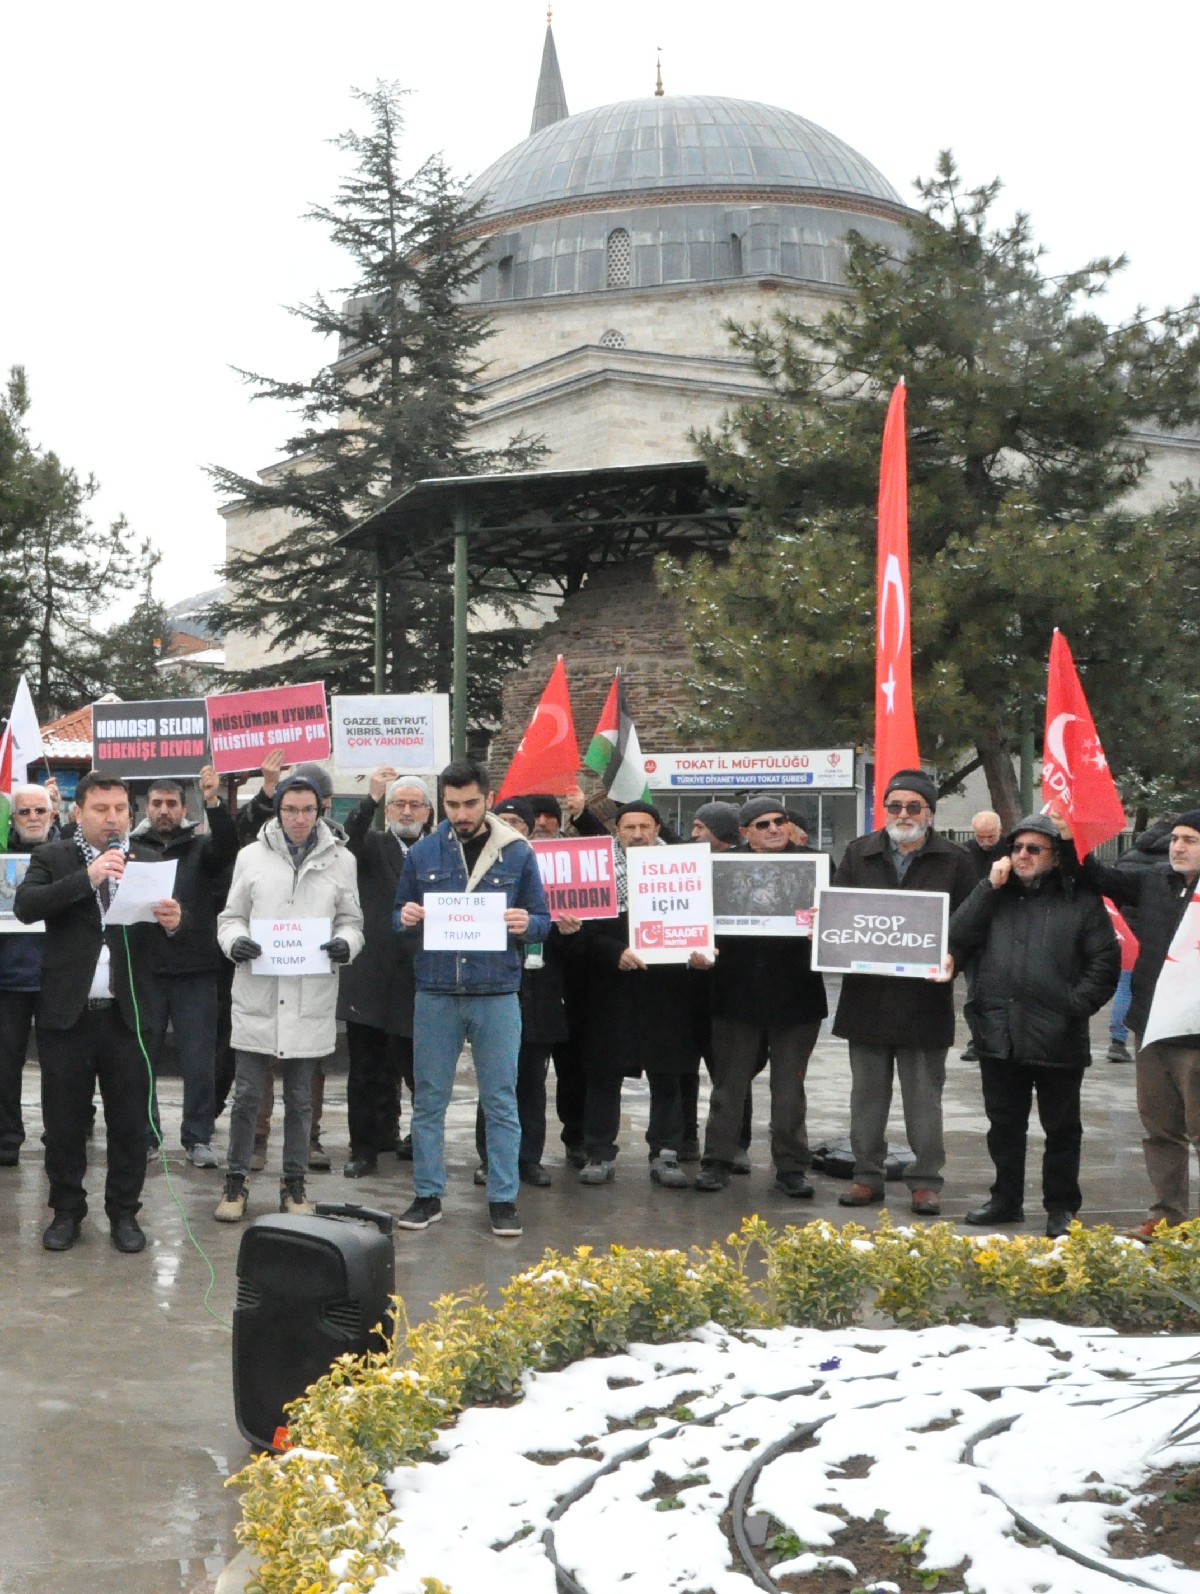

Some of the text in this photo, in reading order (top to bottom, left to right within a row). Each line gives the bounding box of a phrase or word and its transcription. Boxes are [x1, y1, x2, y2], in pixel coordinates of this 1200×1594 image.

[212, 704, 323, 732] MÜSLÜMAN UYUMA
[343, 717, 381, 726] GAZZE,
[97, 717, 204, 738] HAMASA SELAM
[213, 724, 326, 752] FİLİSTİNE SAHİP ÇIK
[348, 737, 424, 749] ÇOK YAKINDA!
[98, 739, 204, 762] DİRENİŞE DEVAM
[675, 755, 809, 769] TOKAT İL MÜFTÜLÜĞÜ
[757, 775, 781, 783] TOKAT
[536, 848, 611, 885] NA NE
[642, 861, 697, 876] İSLAM
[639, 876, 702, 894] BİRLİĞİ
[438, 897, 486, 906] DON'T BE
[652, 896, 690, 914] İÇİN
[448, 914, 475, 922] FOOL
[853, 914, 906, 931] STOP
[272, 923, 303, 931] APTAL
[664, 927, 705, 938] SAADET
[444, 931, 481, 940] TRUMP
[821, 929, 937, 948] GENOCIDE
[273, 939, 303, 948] OLMA
[270, 956, 306, 965] TRUMP
